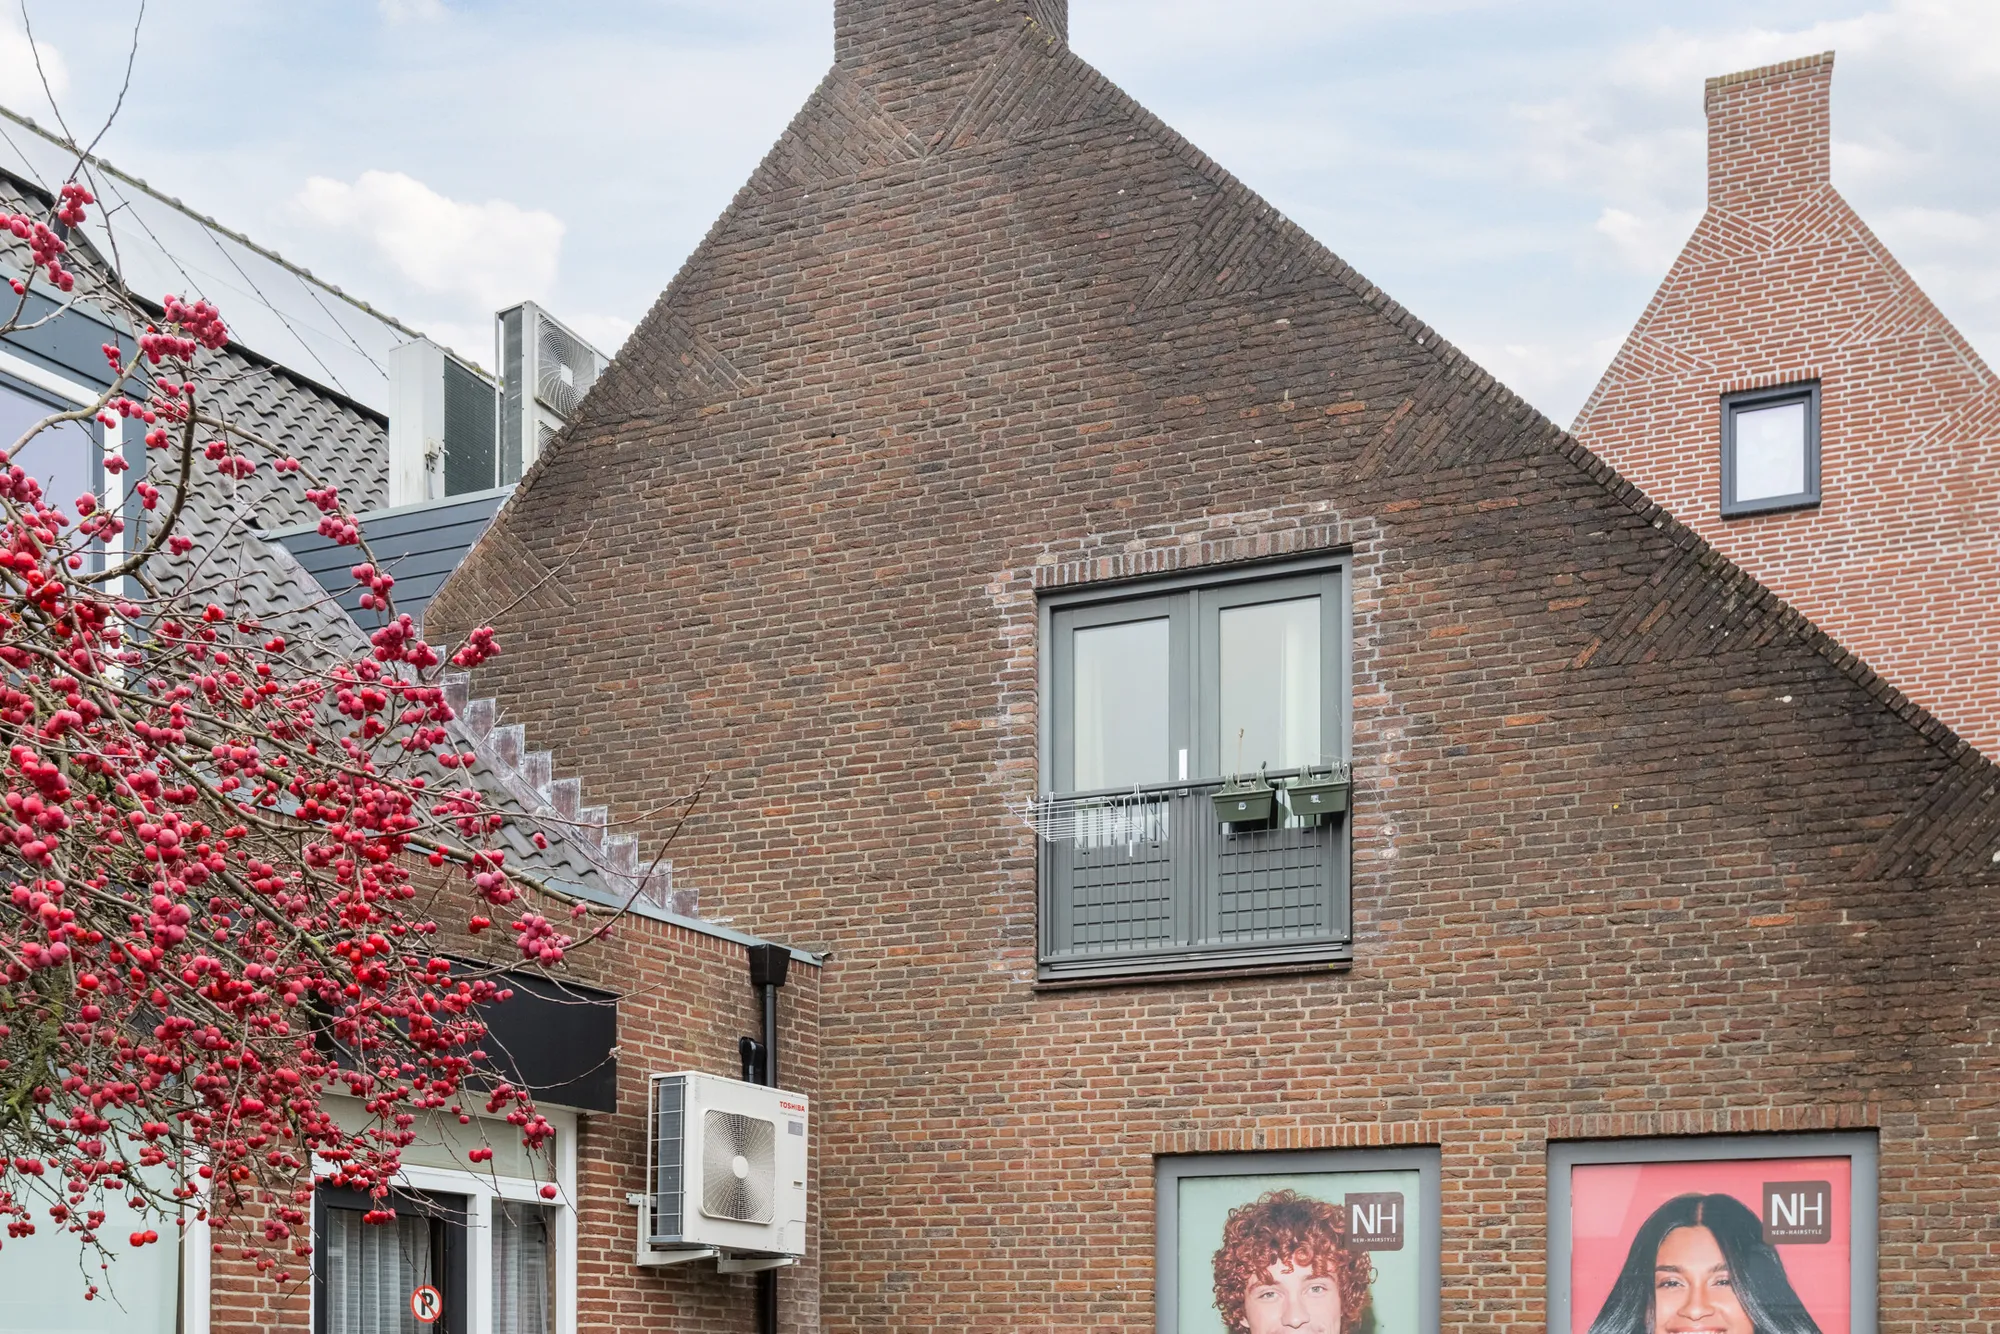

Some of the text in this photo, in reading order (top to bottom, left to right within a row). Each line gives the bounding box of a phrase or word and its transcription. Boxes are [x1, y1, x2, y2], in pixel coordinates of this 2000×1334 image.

[780, 1101, 805, 1112] TOSHIBA
[1352, 1204, 1396, 1234] NH
[1771, 1193, 1822, 1226] NH
